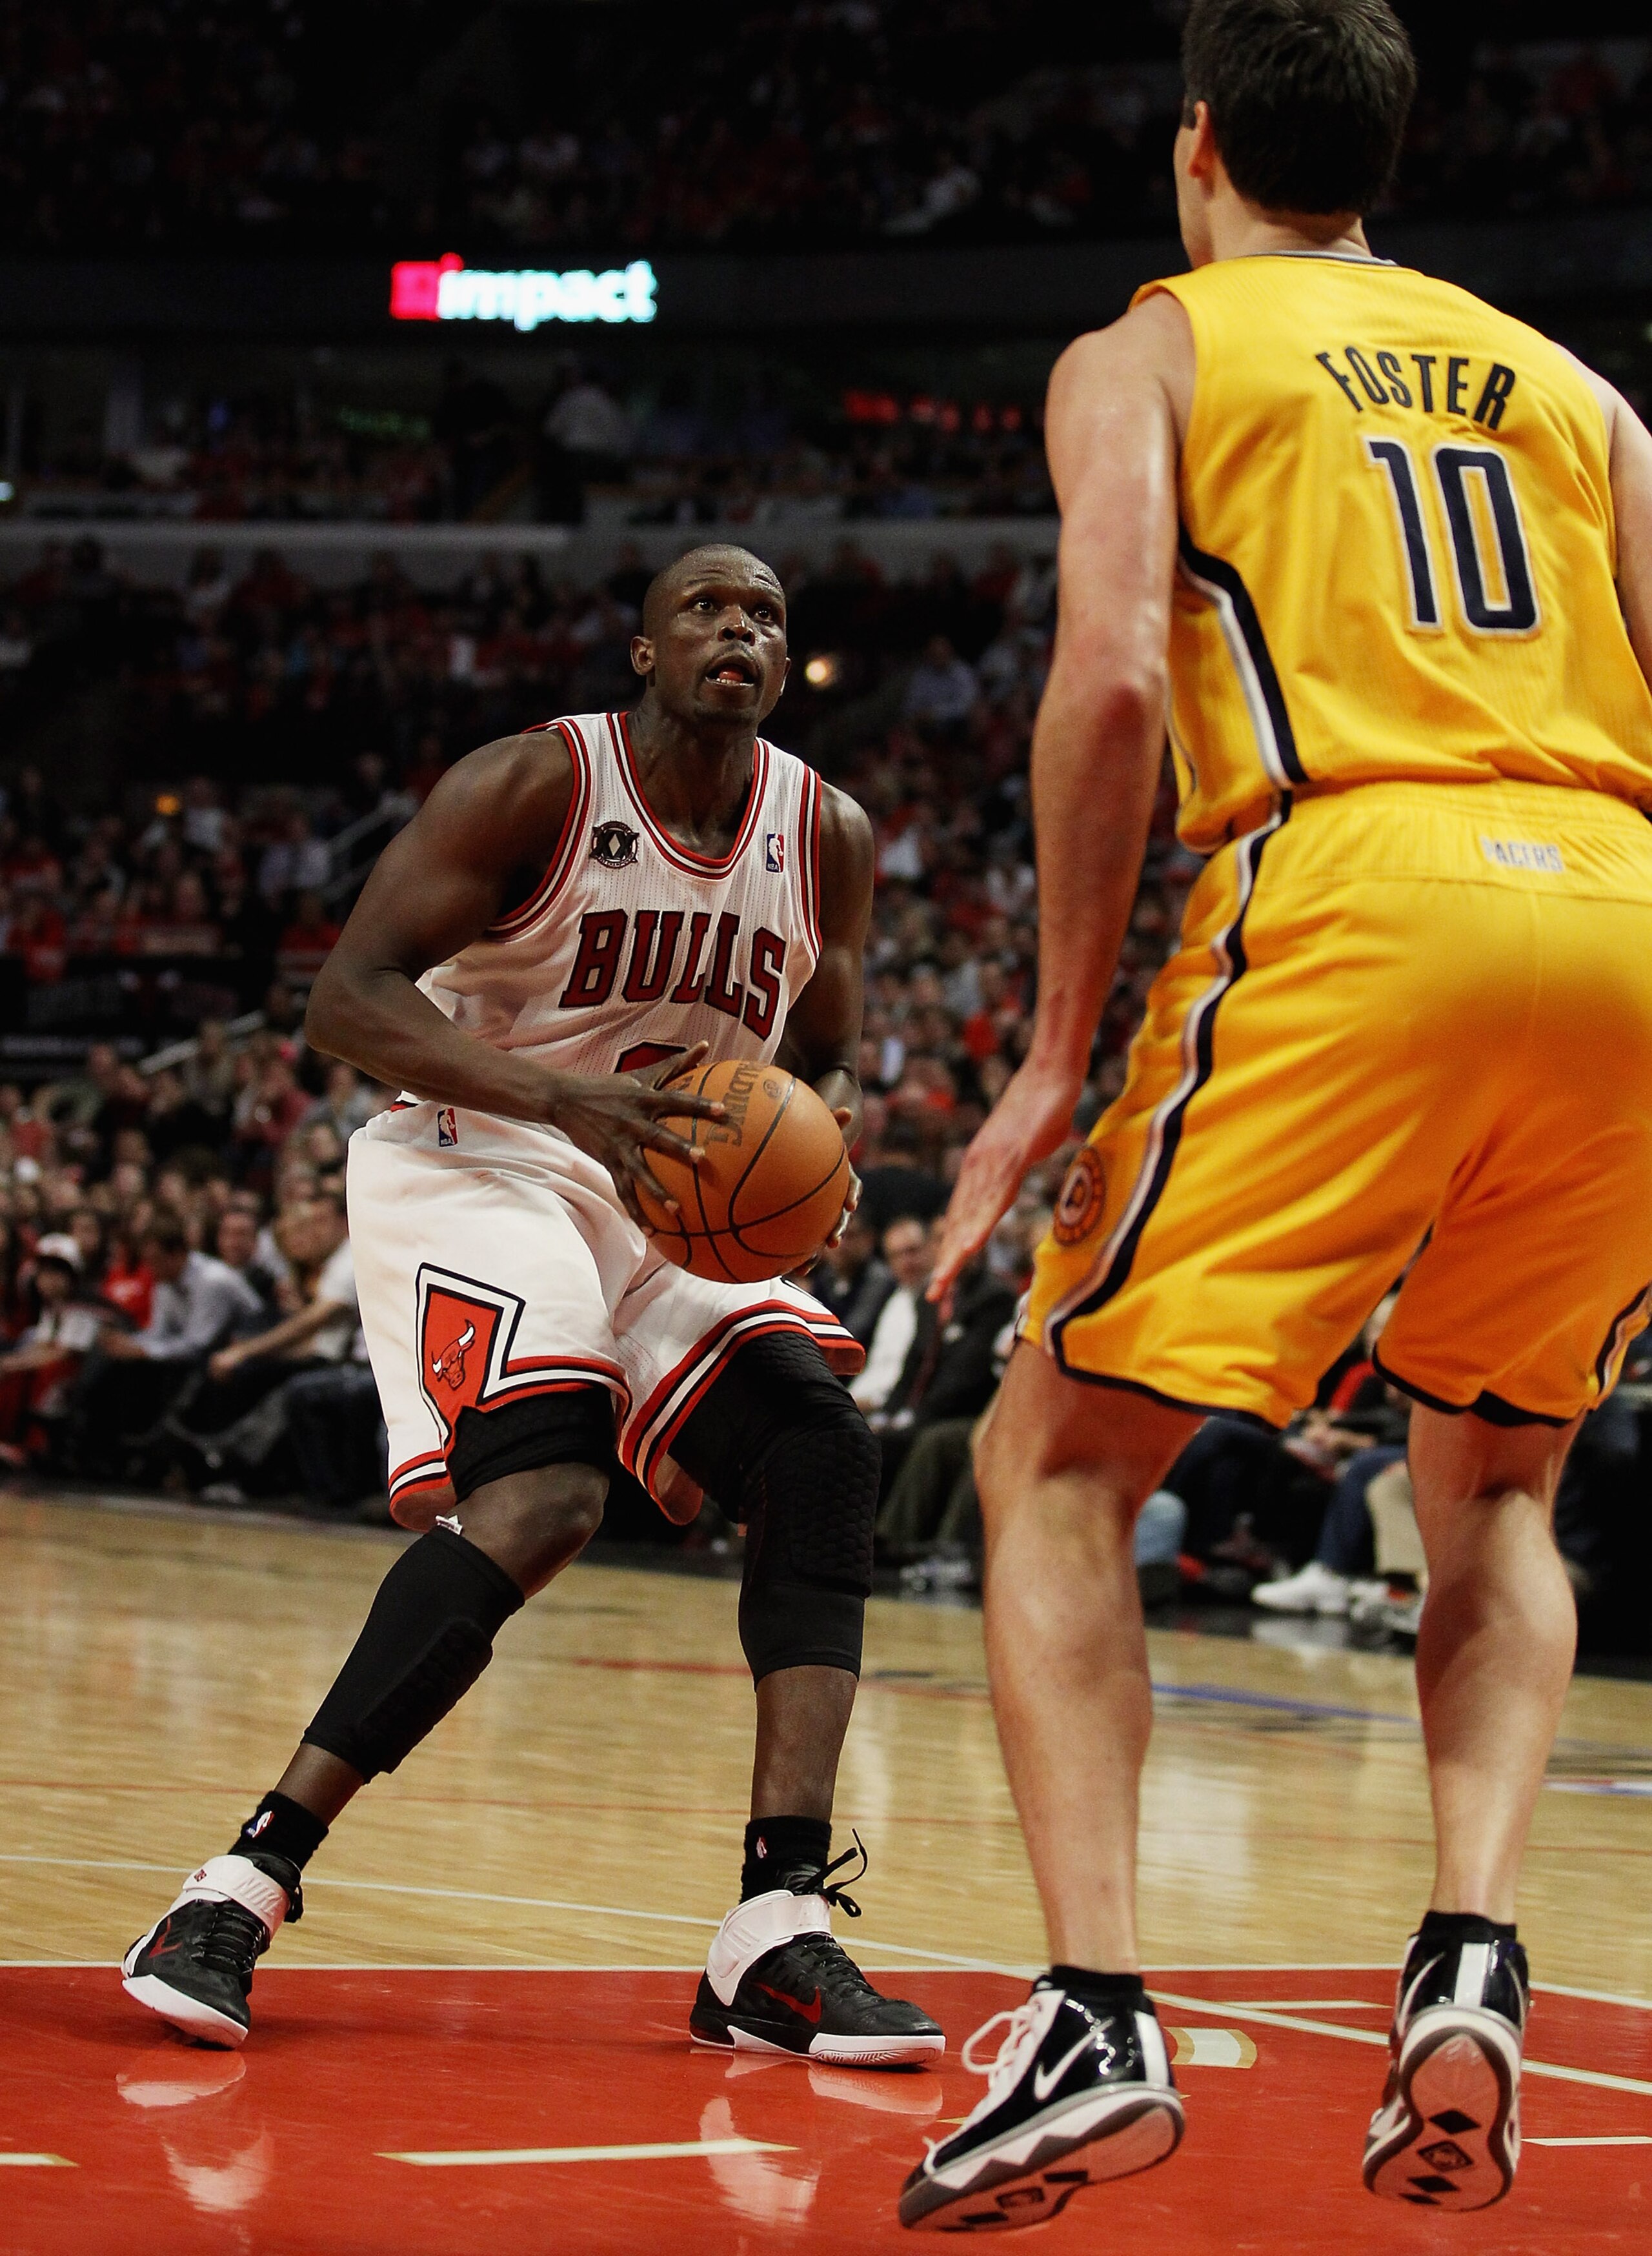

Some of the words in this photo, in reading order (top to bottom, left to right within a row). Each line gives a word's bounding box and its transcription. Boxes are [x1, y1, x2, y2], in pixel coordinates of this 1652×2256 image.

[1315, 346, 1516, 430] FOSTER
[1361, 435, 1541, 636] 10
[558, 909, 787, 1042] BULLS
[233, 1874, 283, 1918] NIKE
